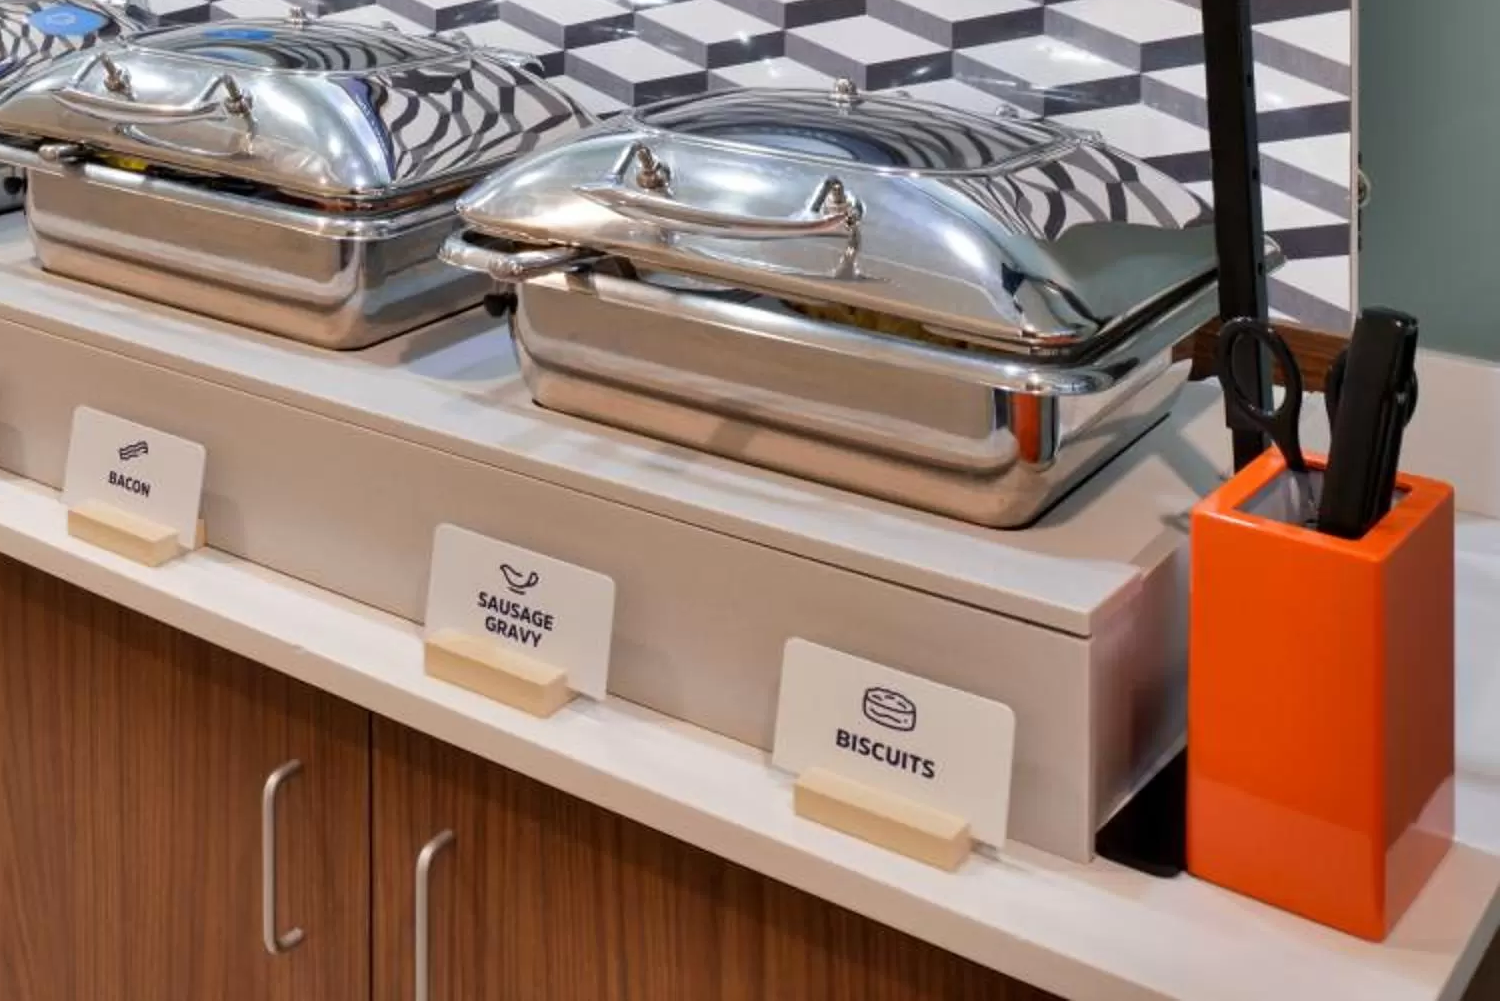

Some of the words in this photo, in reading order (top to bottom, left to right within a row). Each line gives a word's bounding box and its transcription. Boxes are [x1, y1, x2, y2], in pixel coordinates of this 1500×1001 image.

[108, 470, 150, 497] BACON
[477, 591, 554, 631] SAUSAGE
[485, 616, 542, 648] GRAVY
[835, 728, 936, 779] BISCUITS
